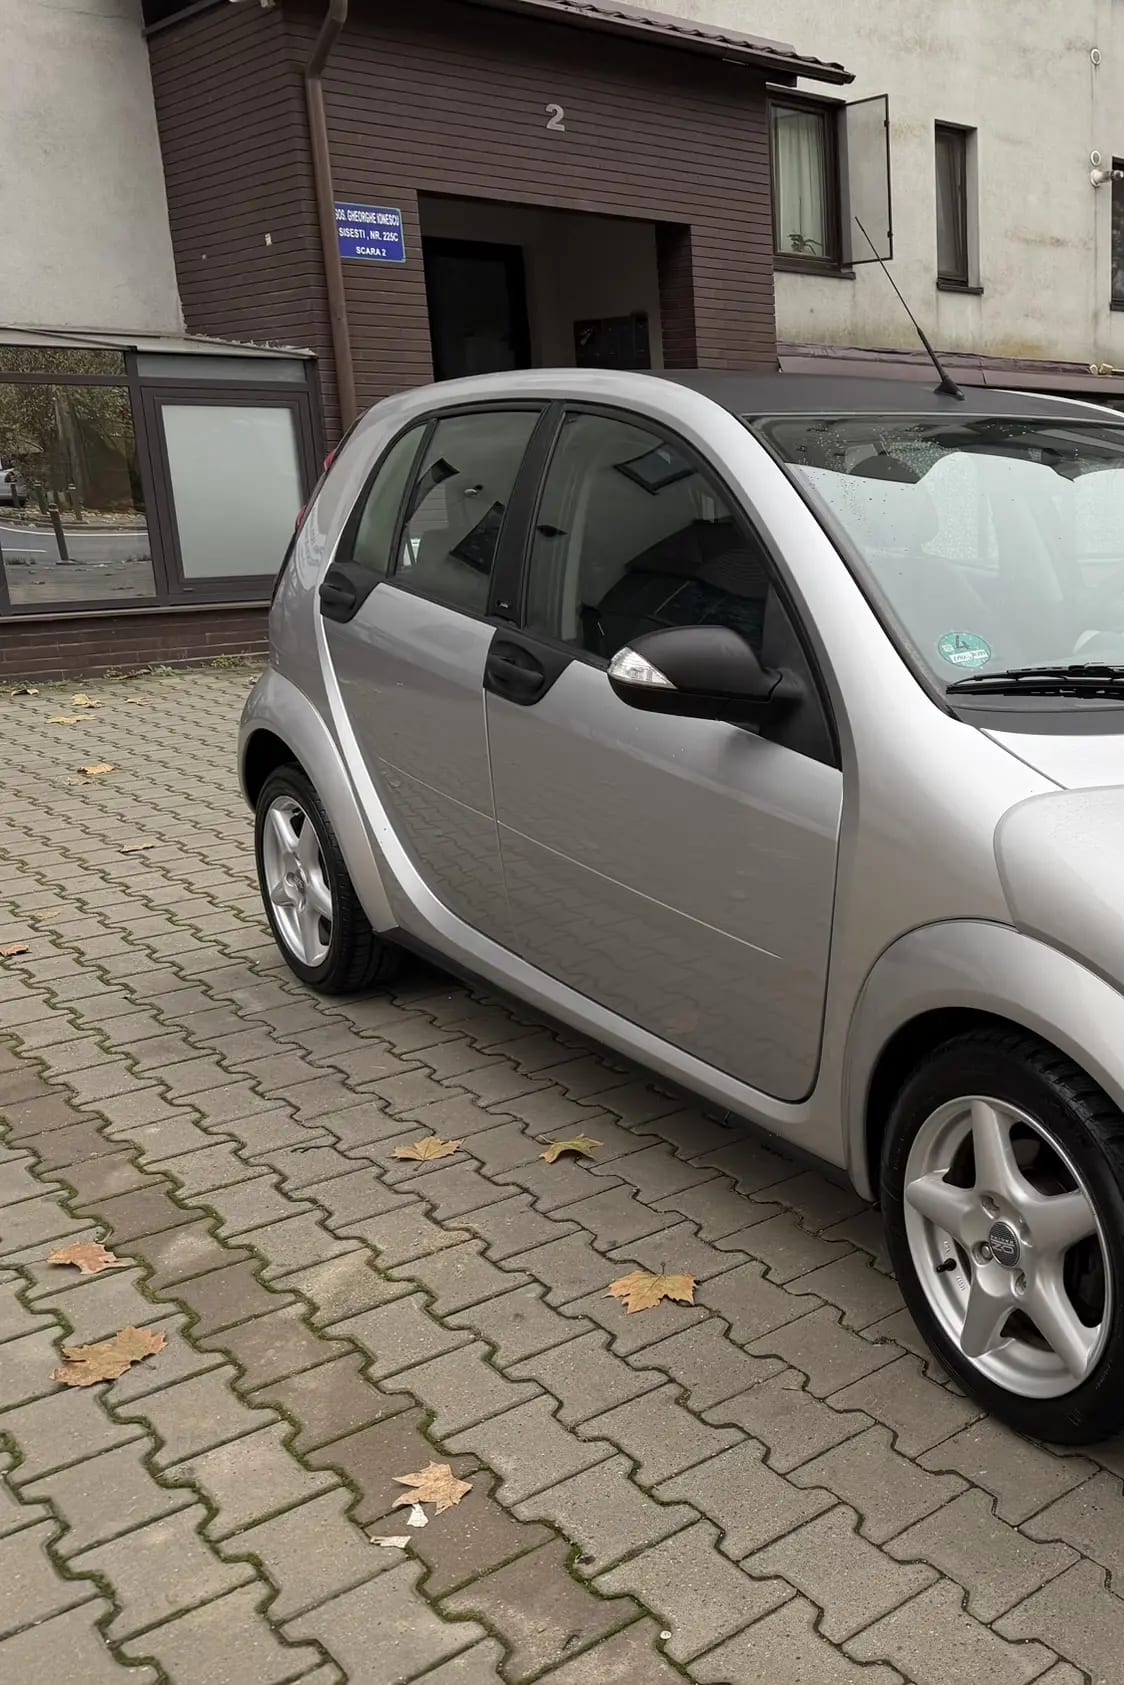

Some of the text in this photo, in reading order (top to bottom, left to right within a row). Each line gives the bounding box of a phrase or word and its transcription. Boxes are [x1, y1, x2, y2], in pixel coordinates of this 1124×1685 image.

[545, 103, 565, 131] 2
[347, 209, 377, 224] GHEORGHE
[377, 213, 400, 226] IONESCU
[370, 230, 382, 241] NR.
[383, 231, 399, 242] 225C
[355, 246, 387, 257] SCARA 2
[953, 634, 970, 650] 4
